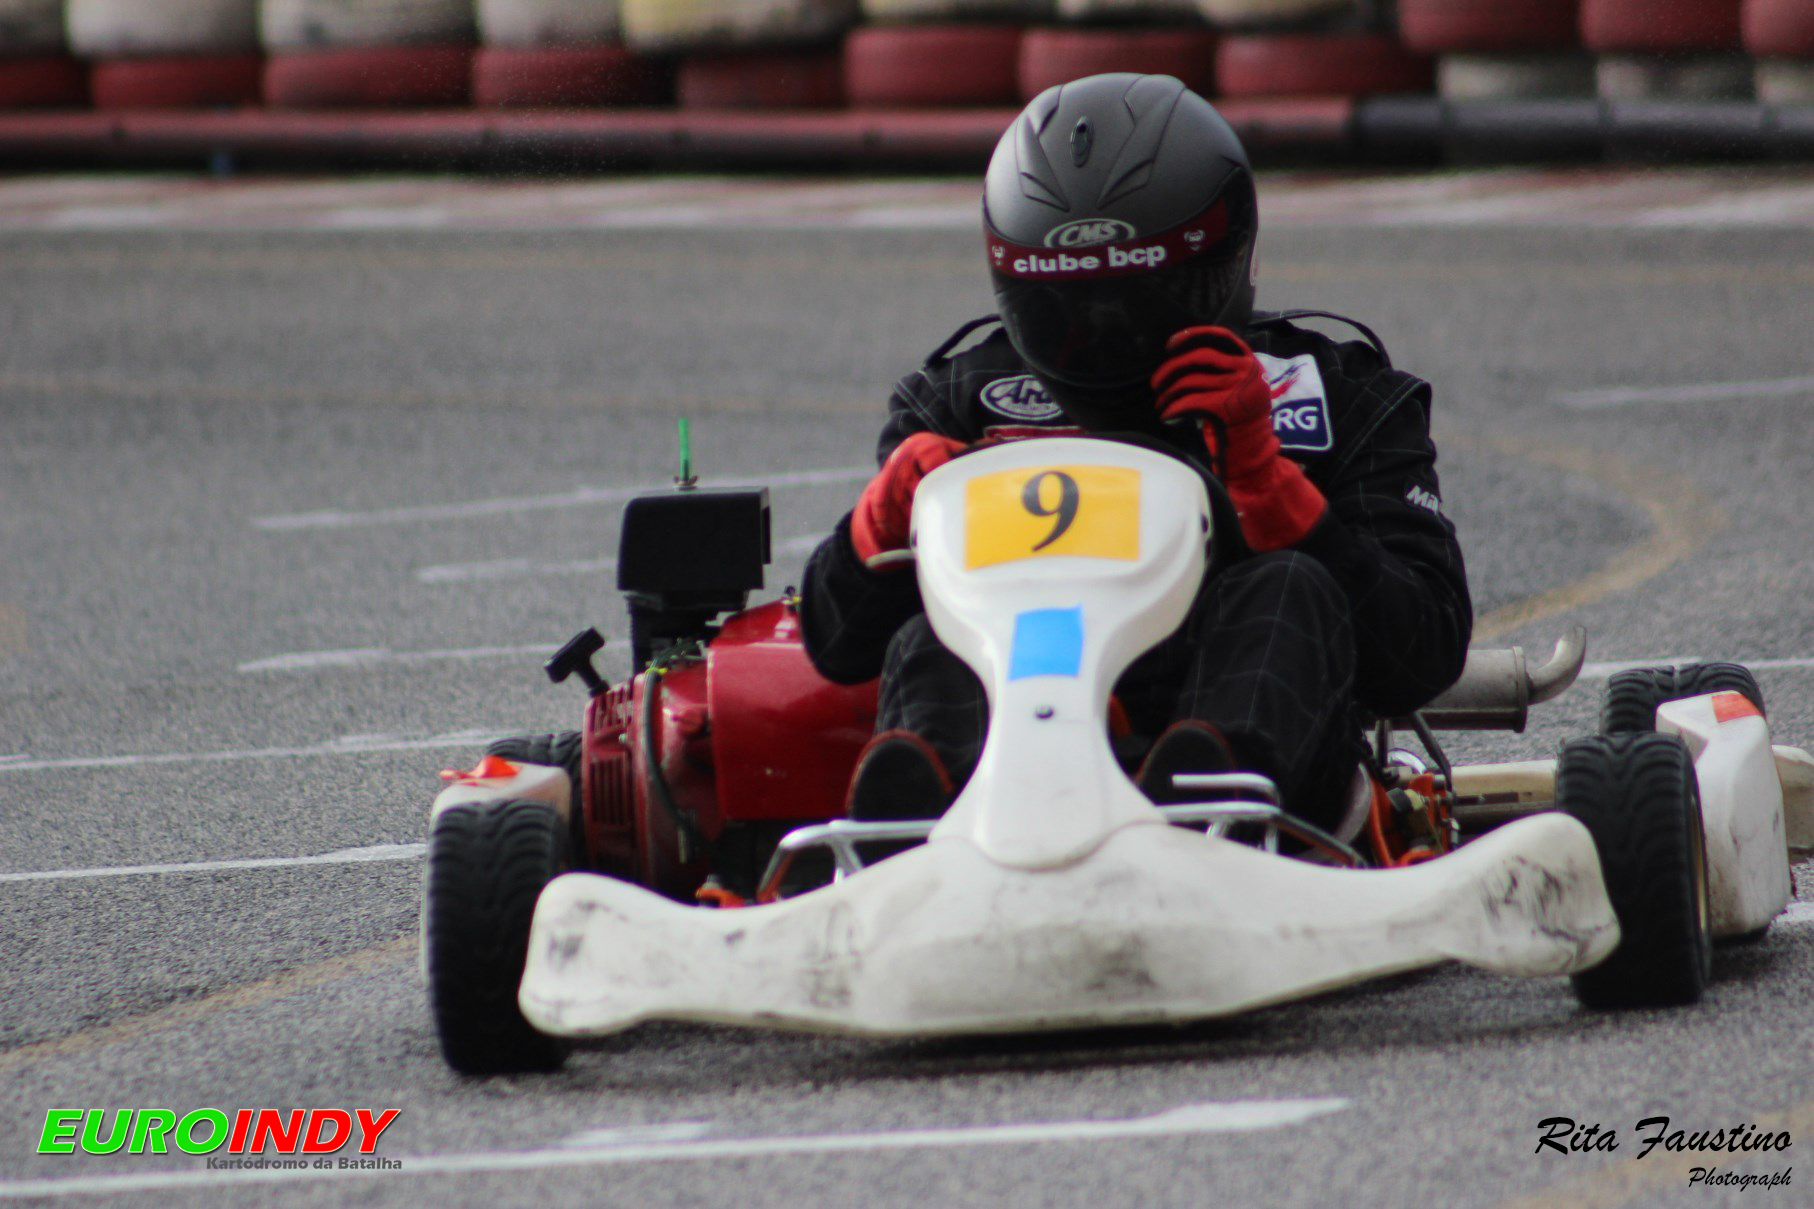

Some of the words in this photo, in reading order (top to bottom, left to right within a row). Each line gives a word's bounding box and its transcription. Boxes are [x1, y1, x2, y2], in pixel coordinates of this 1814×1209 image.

[1058, 222, 1118, 246] CMS
[1013, 254, 1099, 273] clube
[1107, 245, 1167, 268] bcp
[1270, 406, 1318, 431] RG
[1020, 470, 1080, 553] 9
